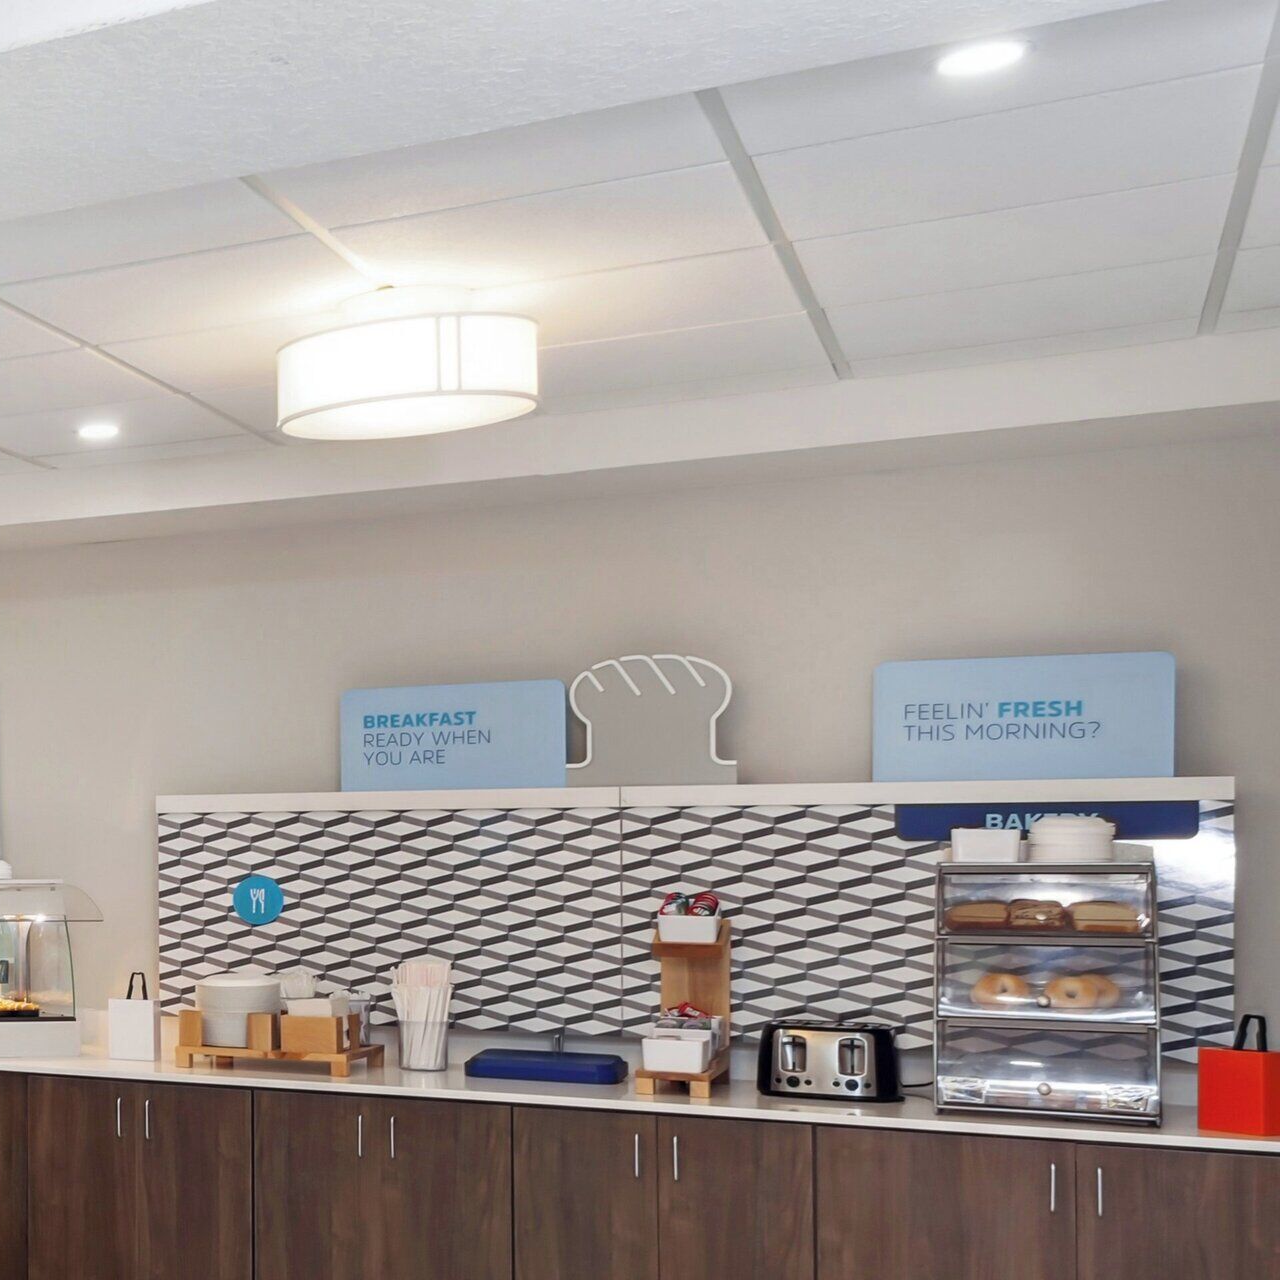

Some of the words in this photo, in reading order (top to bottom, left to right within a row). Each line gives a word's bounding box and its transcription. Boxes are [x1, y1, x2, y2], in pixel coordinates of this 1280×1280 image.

[997, 700, 1083, 719] FRESH
[362, 710, 477, 729] BREAKFAST
[362, 731, 425, 748] READY
[431, 729, 491, 746] WHEN
[903, 723, 956, 742] THIS
[965, 720, 1102, 742] MORNING?
[363, 750, 403, 767] YOU
[408, 749, 446, 765] ARE
[985, 812, 1099, 830] BAK
